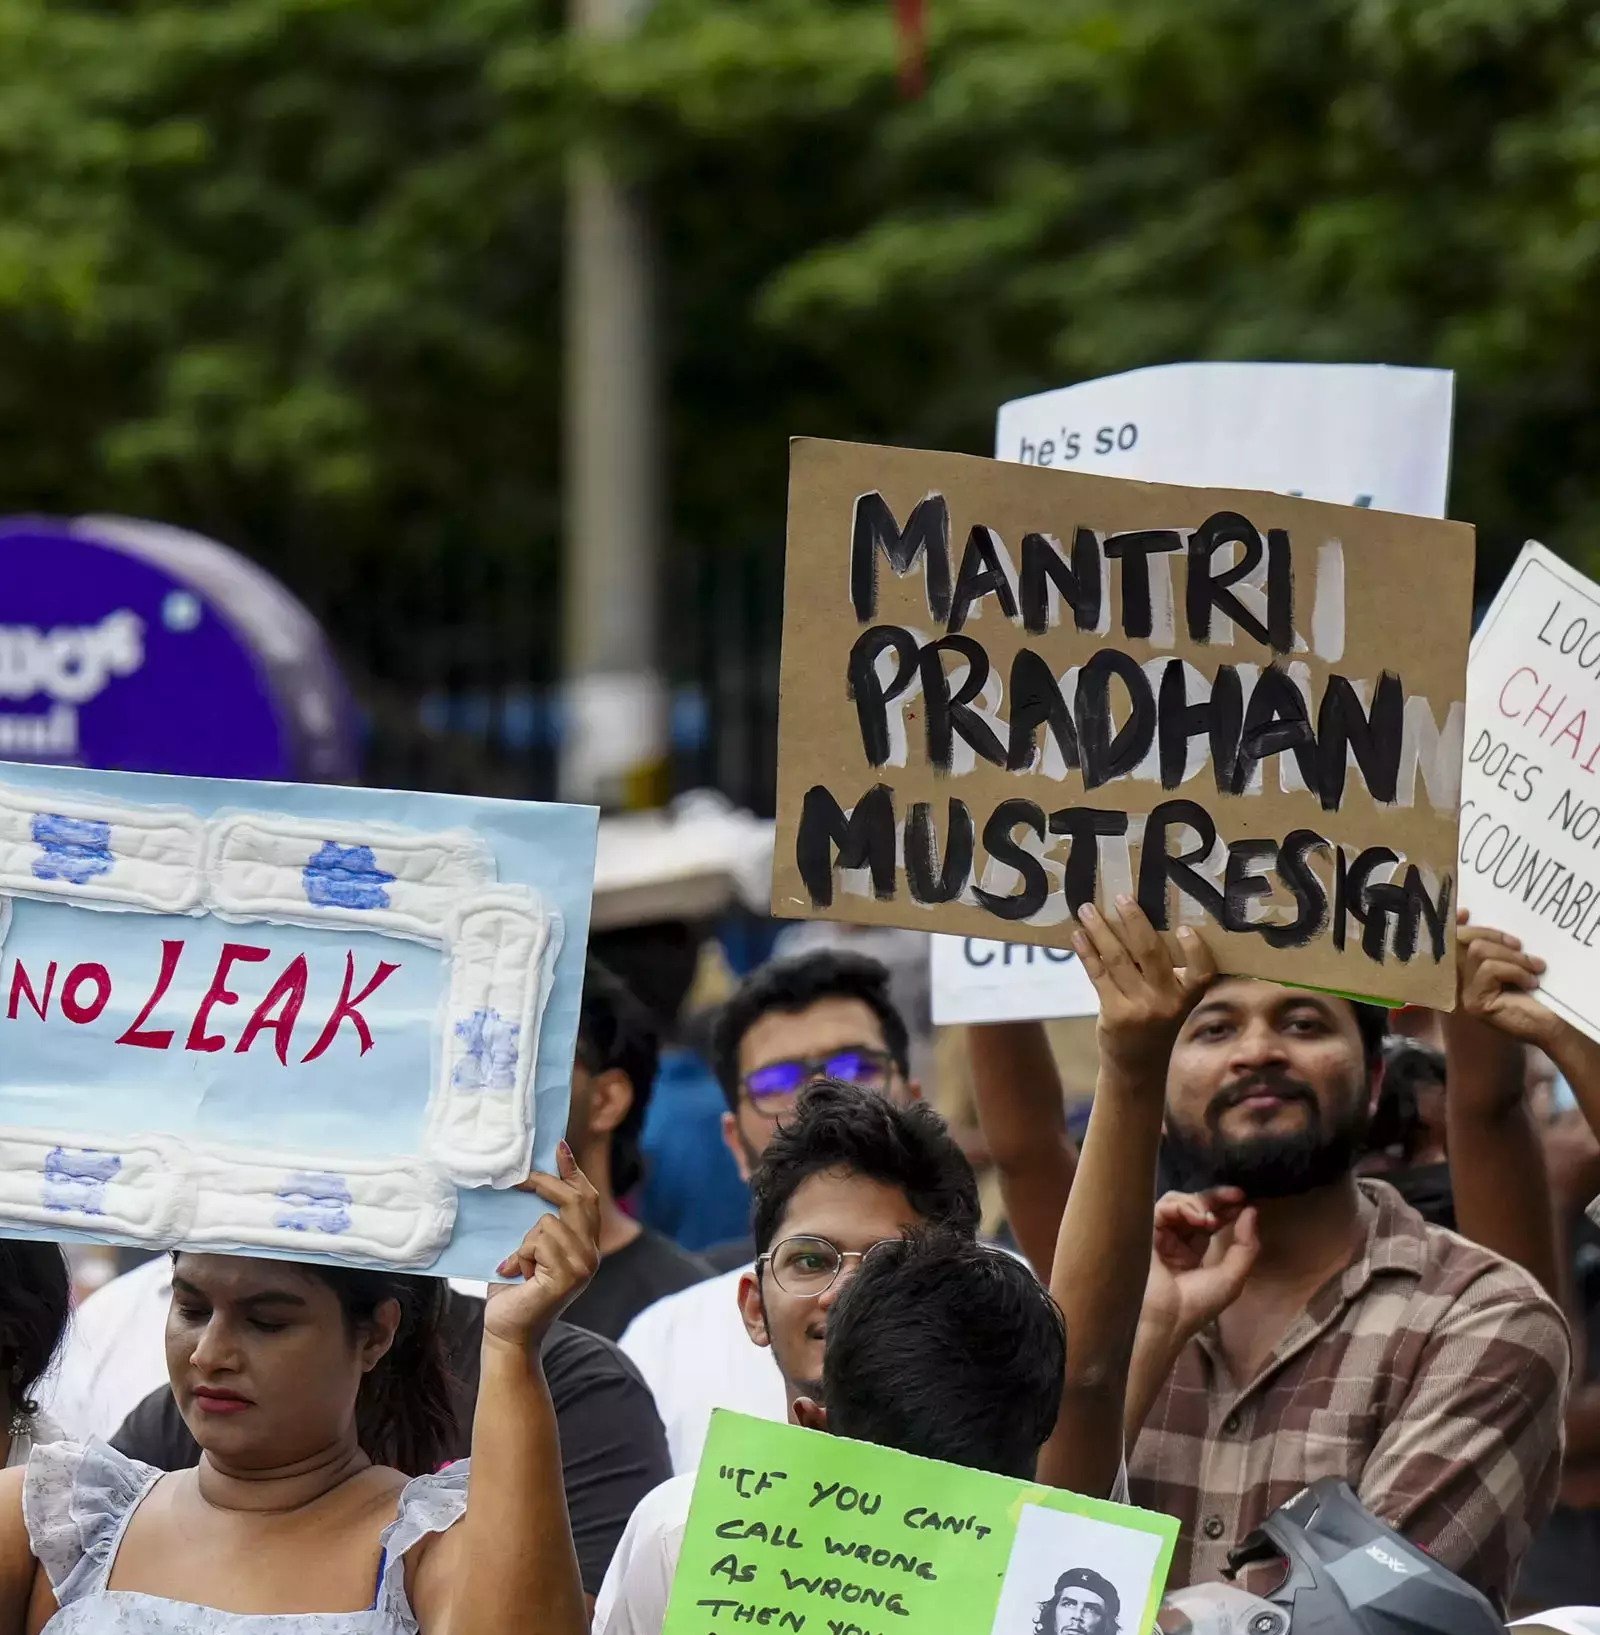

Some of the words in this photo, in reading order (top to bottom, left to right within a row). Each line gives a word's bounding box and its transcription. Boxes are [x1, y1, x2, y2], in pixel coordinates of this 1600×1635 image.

[1019, 428, 1081, 466] he's
[1094, 422, 1139, 453] so
[849, 490, 1295, 653] MANTRI
[1537, 600, 1600, 680] LOO
[847, 624, 1404, 813] PRADHAN
[1468, 728, 1543, 802] DOES
[1547, 788, 1600, 852] NO
[796, 783, 1129, 927] MUST
[1136, 799, 1453, 965] RESIGN
[7, 958, 112, 1024] NO
[114, 939, 400, 1068] LEAK
[808, 1477, 884, 1518] YOU
[902, 1505, 993, 1542] CAN'T
[710, 1553, 756, 1587] AS
[779, 1568, 912, 1619] WRONG
[713, 1518, 805, 1551] CALL
[824, 1538, 939, 1582] WRONG
[697, 1598, 806, 1635] THEN
